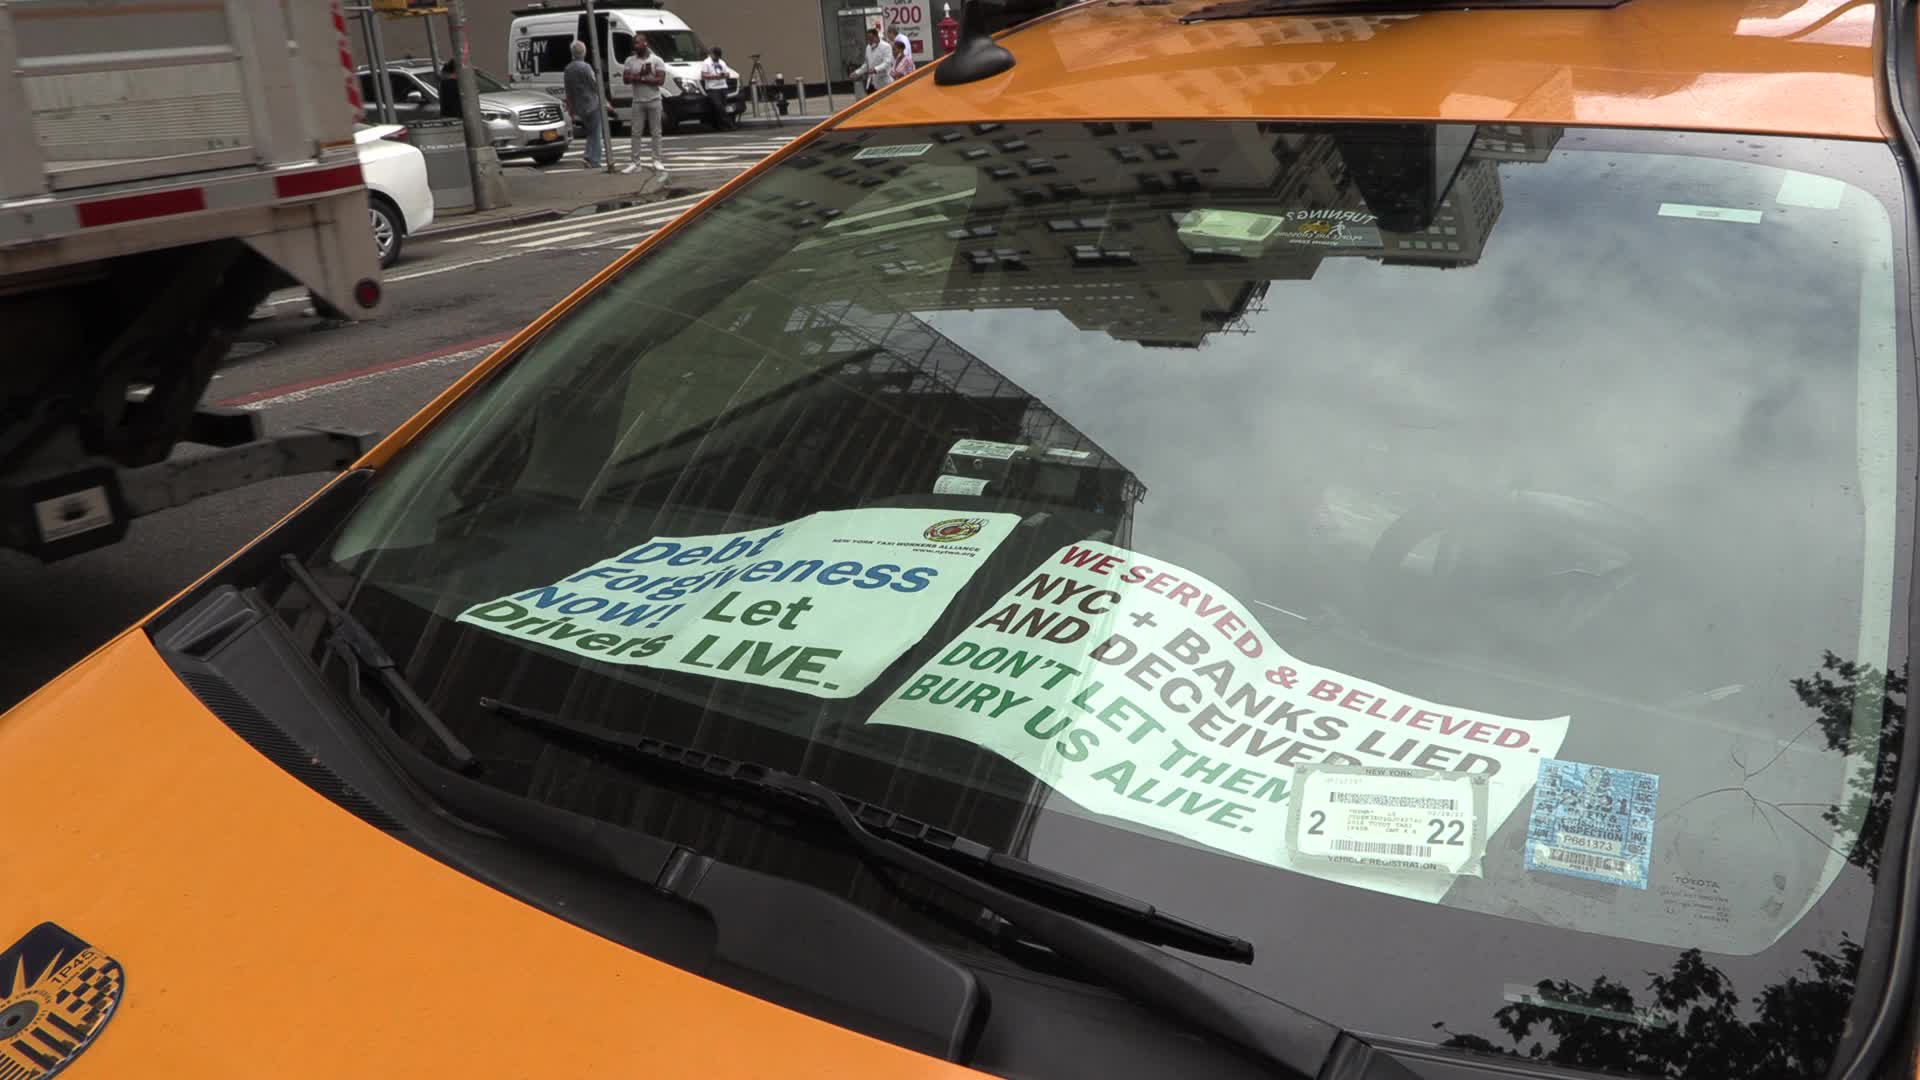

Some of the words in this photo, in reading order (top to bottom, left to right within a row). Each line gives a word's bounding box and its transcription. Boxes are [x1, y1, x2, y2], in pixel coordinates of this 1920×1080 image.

[884, 5, 922, 25] $200
[532, 41, 548, 54] NY
[533, 55, 540, 75] 1
[616, 528, 784, 567] Debt
[938, 544, 981, 552] ALLIANCE
[566, 559, 938, 601] Forgiveness
[702, 591, 814, 631] Let
[975, 603, 1091, 645] AND
[467, 600, 674, 658] Drivers
[679, 634, 843, 691] LIVE.
[1059, 546, 1126, 576] WE
[1120, 565, 1264, 659] SERVED
[1265, 666, 1299, 689] &
[1307, 679, 1542, 754] BELIEVED.
[938, 641, 1082, 691] DON'T
[1071, 681, 1166, 745] LET
[1015, 573, 1122, 615] NYC
[1129, 611, 1158, 628] +
[1163, 627, 1349, 742] BANKS
[1356, 729, 1502, 778] LIED
[900, 673, 1032, 720] BURY
[1023, 705, 1100, 762] US
[1090, 760, 1257, 833] ALIVE.
[1365, 768, 1386, 776] NEW
[1388, 769, 1414, 778] YORK
[1307, 810, 1326, 836] 2
[1426, 818, 1466, 846] 22
[1557, 824, 1624, 843] INSPECTION
[1327, 855, 1370, 866] VEHICLE
[1370, 857, 1437, 871] REGISTRATION
[51, 951, 94, 985] 1P45
